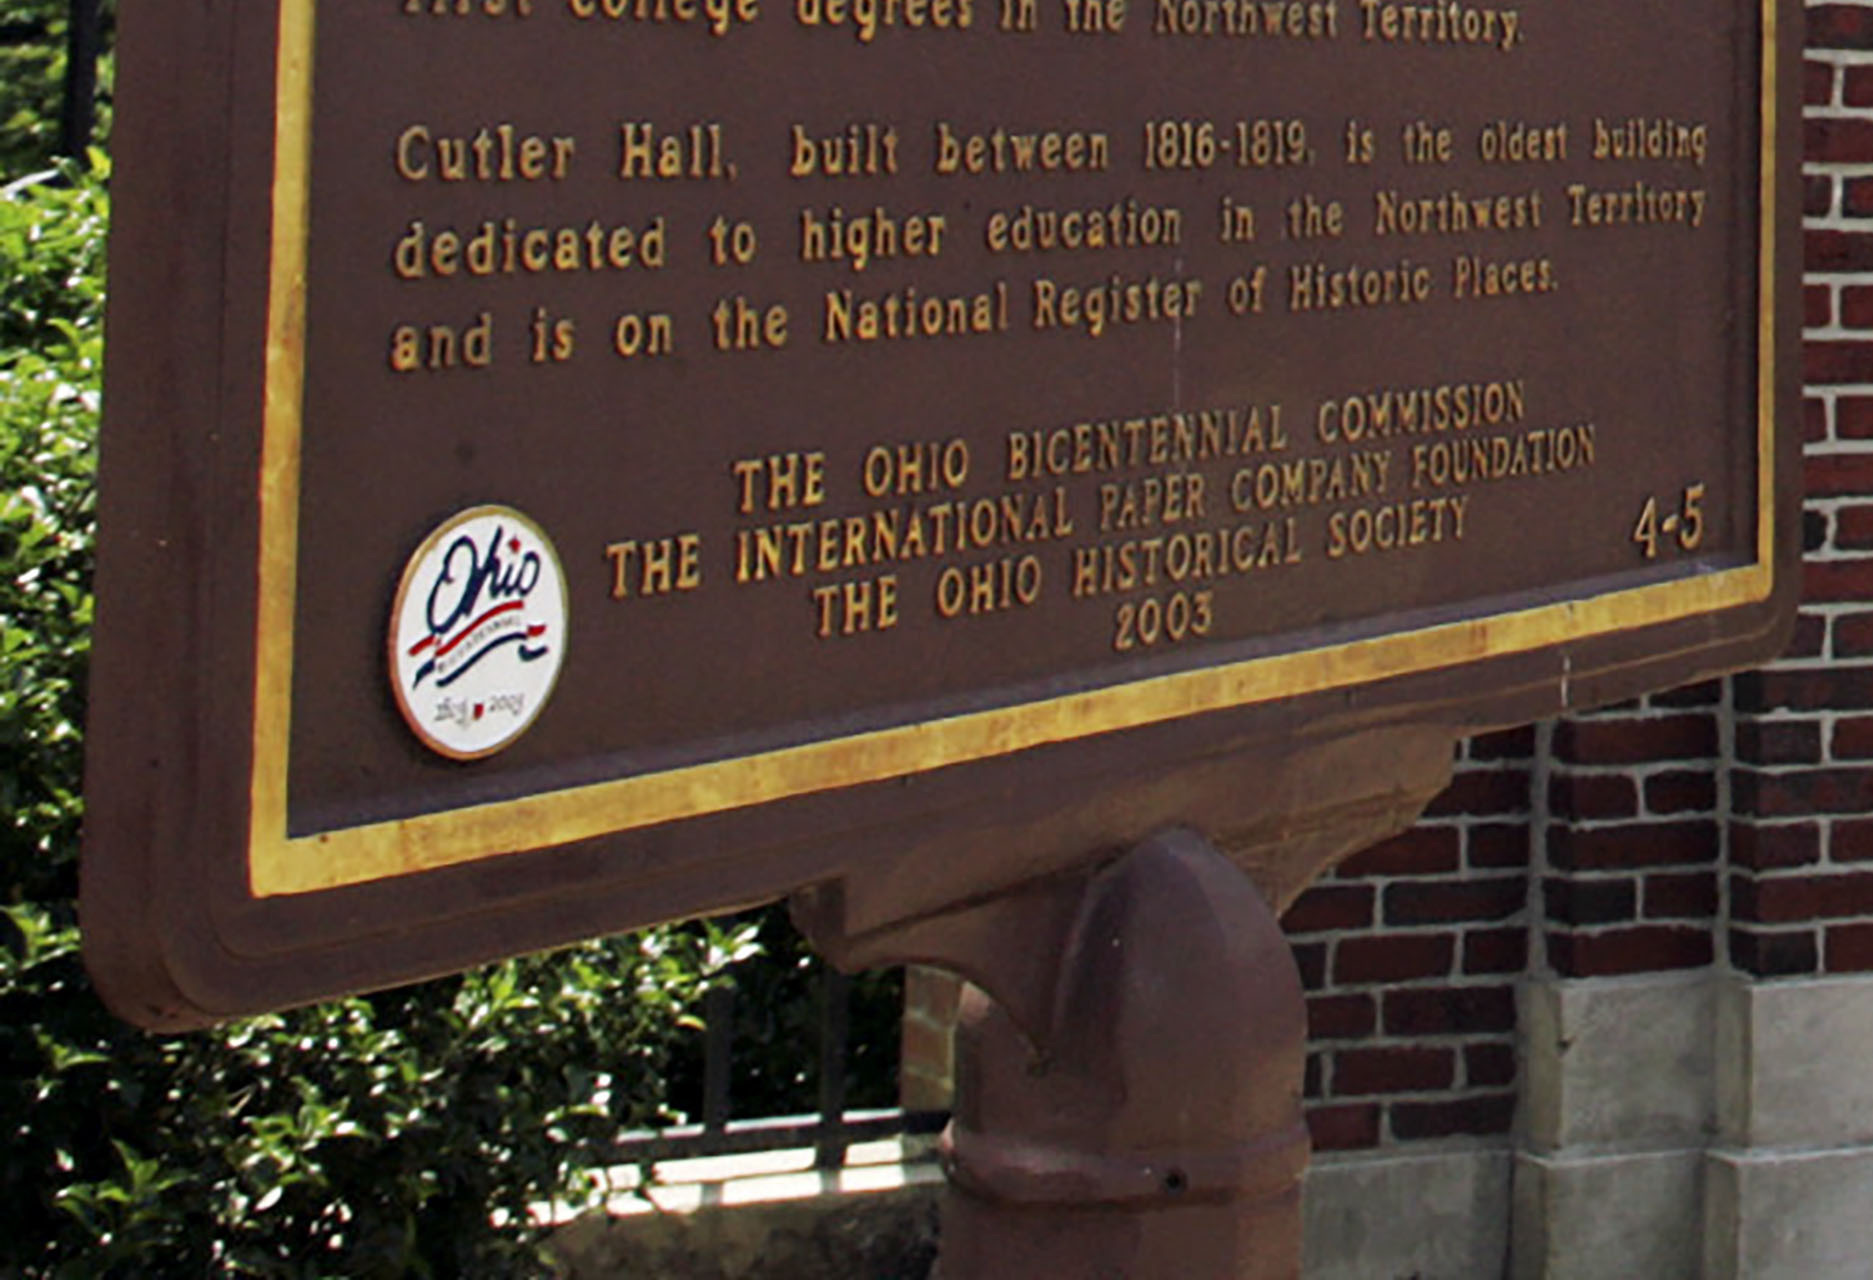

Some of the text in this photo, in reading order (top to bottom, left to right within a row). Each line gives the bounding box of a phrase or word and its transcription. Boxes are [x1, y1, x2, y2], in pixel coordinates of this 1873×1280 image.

[398, 124, 574, 180] Cutler
[791, 124, 897, 176] built
[938, 123, 1107, 172] between
[1348, 121, 1373, 162] is
[1404, 121, 1451, 162] the
[1482, 121, 1566, 160] oldest
[1594, 118, 1707, 165] building
[396, 181, 1705, 277] dedicated to higher education in the Northwest Territory
[392, 313, 491, 371] and
[534, 308, 573, 362] is
[617, 314, 671, 356] on
[714, 297, 787, 349] the
[826, 282, 1007, 342] National
[1034, 275, 1202, 337] Register
[1230, 266, 1266, 313] of
[1291, 260, 1429, 310] Historic
[734, 381, 1523, 514] THE OHIO BICENTENNIAL COMMISSION
[606, 425, 1594, 597] THE INTERNATIONAL PAPER COMPANY FOUNDATION
[1633, 483, 1706, 558] 4-5
[426, 524, 540, 634] Ohio
[814, 496, 1468, 637] THE OHIO HISTORICAL SOCIETY
[1116, 591, 1212, 650] 2003
